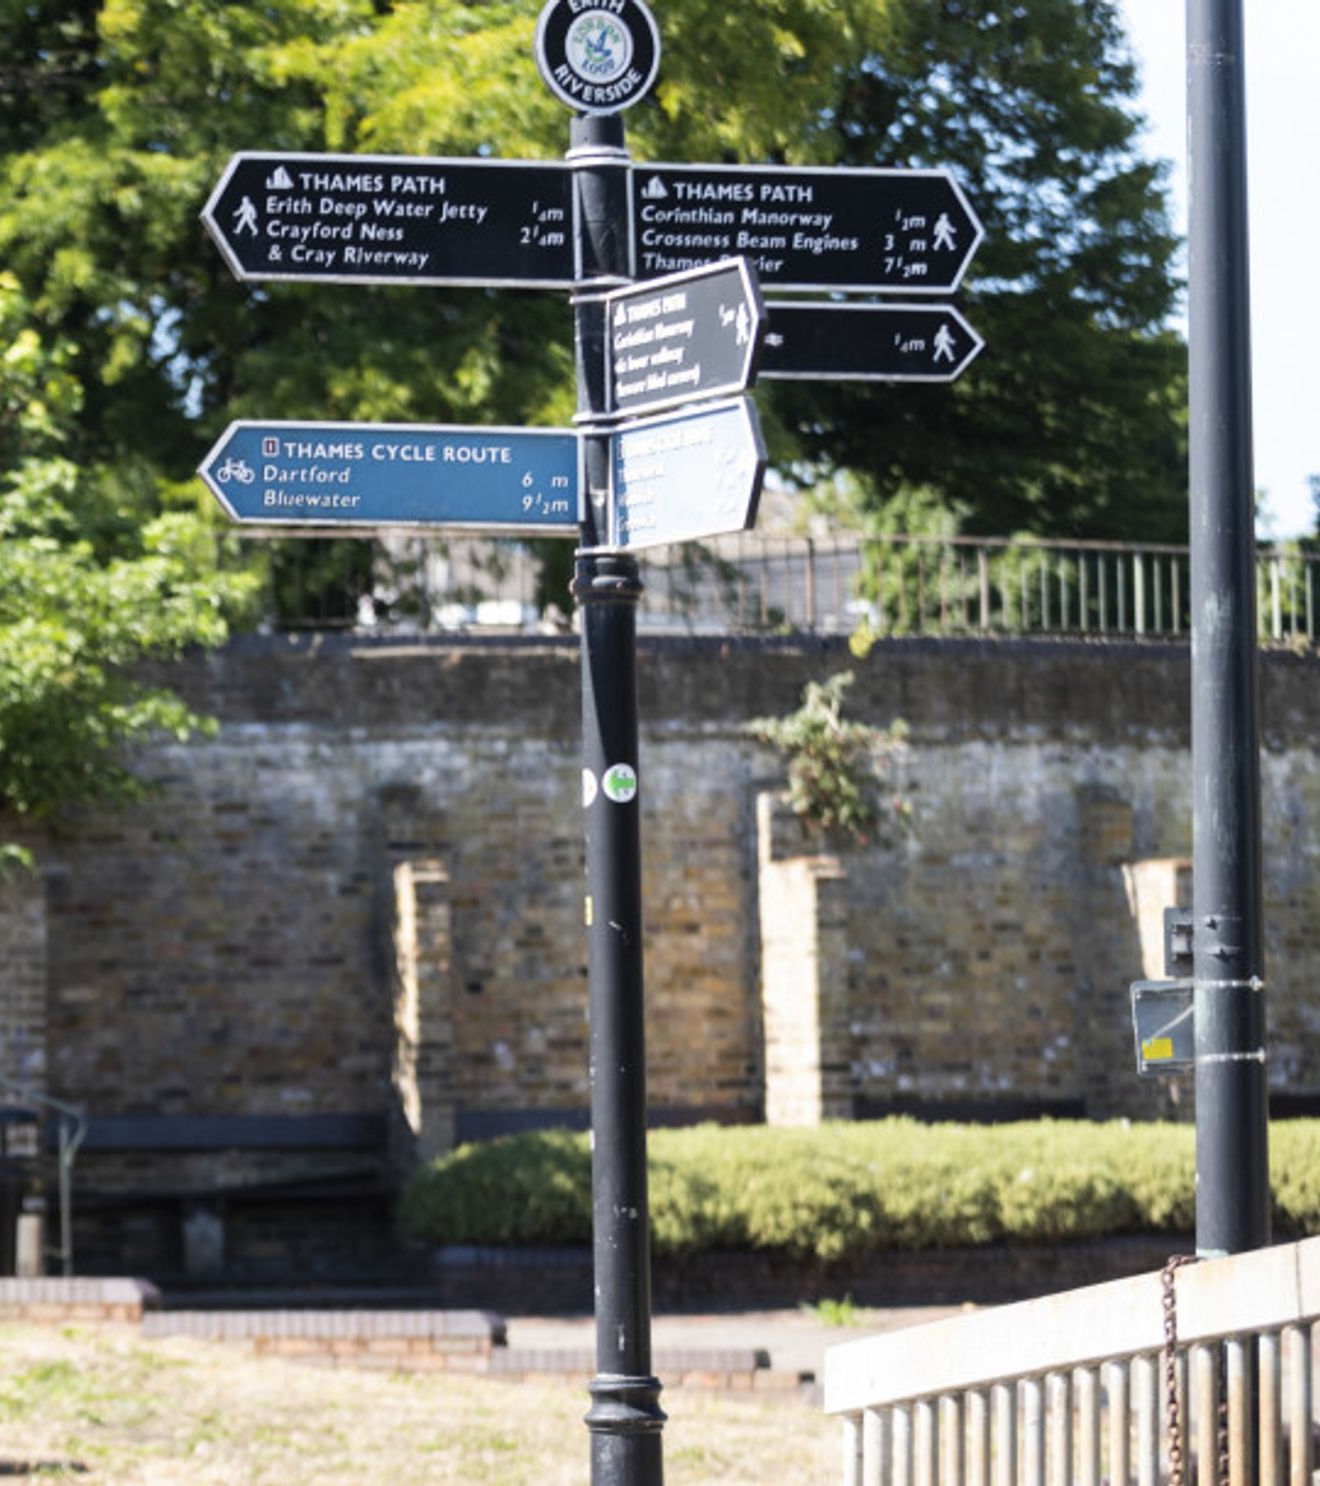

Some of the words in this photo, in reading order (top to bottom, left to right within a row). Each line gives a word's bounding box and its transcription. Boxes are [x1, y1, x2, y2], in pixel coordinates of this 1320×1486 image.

[554, 64, 642, 103] RIVERSIDE
[299, 172, 383, 193] THAMES
[391, 174, 446, 195] PATH
[672, 181, 755, 202] THAMES
[760, 184, 813, 203] PATH
[266, 195, 312, 215] Erith
[320, 196, 368, 221] Deep
[372, 199, 434, 218] Water
[439, 200, 488, 224] Jetty
[641, 204, 735, 225] Corinthian
[741, 206, 833, 231] Manorway
[266, 219, 354, 243] Crayford
[359, 222, 405, 241] Ness
[642, 228, 730, 248] Crossness
[737, 230, 787, 249] Beam
[792, 231, 859, 255] Engines
[884, 233, 895, 251] 3
[268, 243, 283, 261] &
[291, 244, 336, 268] Cray
[344, 246, 430, 271] Riverway
[283, 441, 364, 460] THAMES
[371, 443, 436, 462] CYCLE
[443, 445, 512, 464] ROUTE
[263, 464, 351, 483] Dartford
[522, 470, 533, 488] 6
[263, 488, 360, 508] Bluewater
